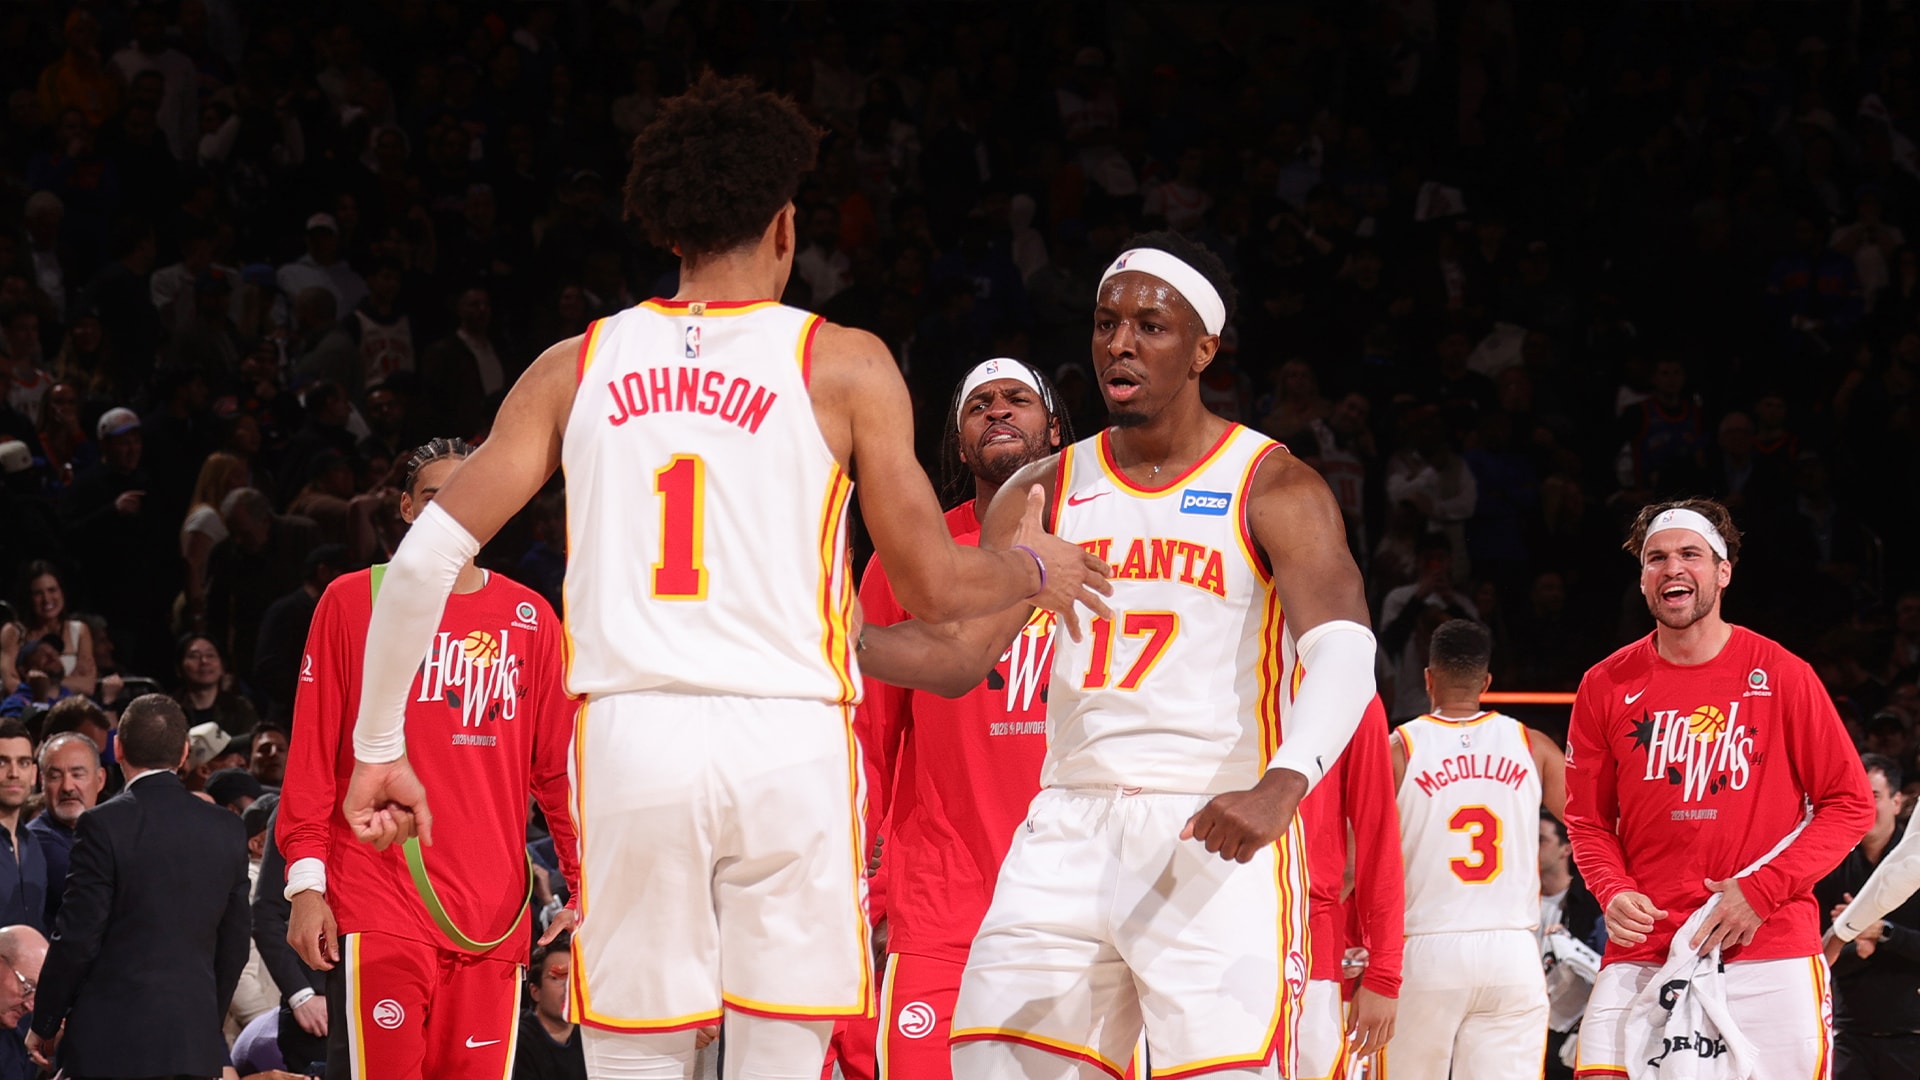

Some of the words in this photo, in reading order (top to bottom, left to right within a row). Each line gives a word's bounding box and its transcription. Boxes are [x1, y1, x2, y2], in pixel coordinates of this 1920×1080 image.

[608, 366, 778, 435] JOHNSON
[650, 453, 709, 602] 1
[1183, 494, 1228, 509] paze
[416, 629, 520, 727] Hawks
[1081, 609, 1180, 692] 17
[1414, 754, 1528, 798] McCOLLUM
[1642, 701, 1754, 802] Hawks
[1447, 804, 1503, 885] 3
